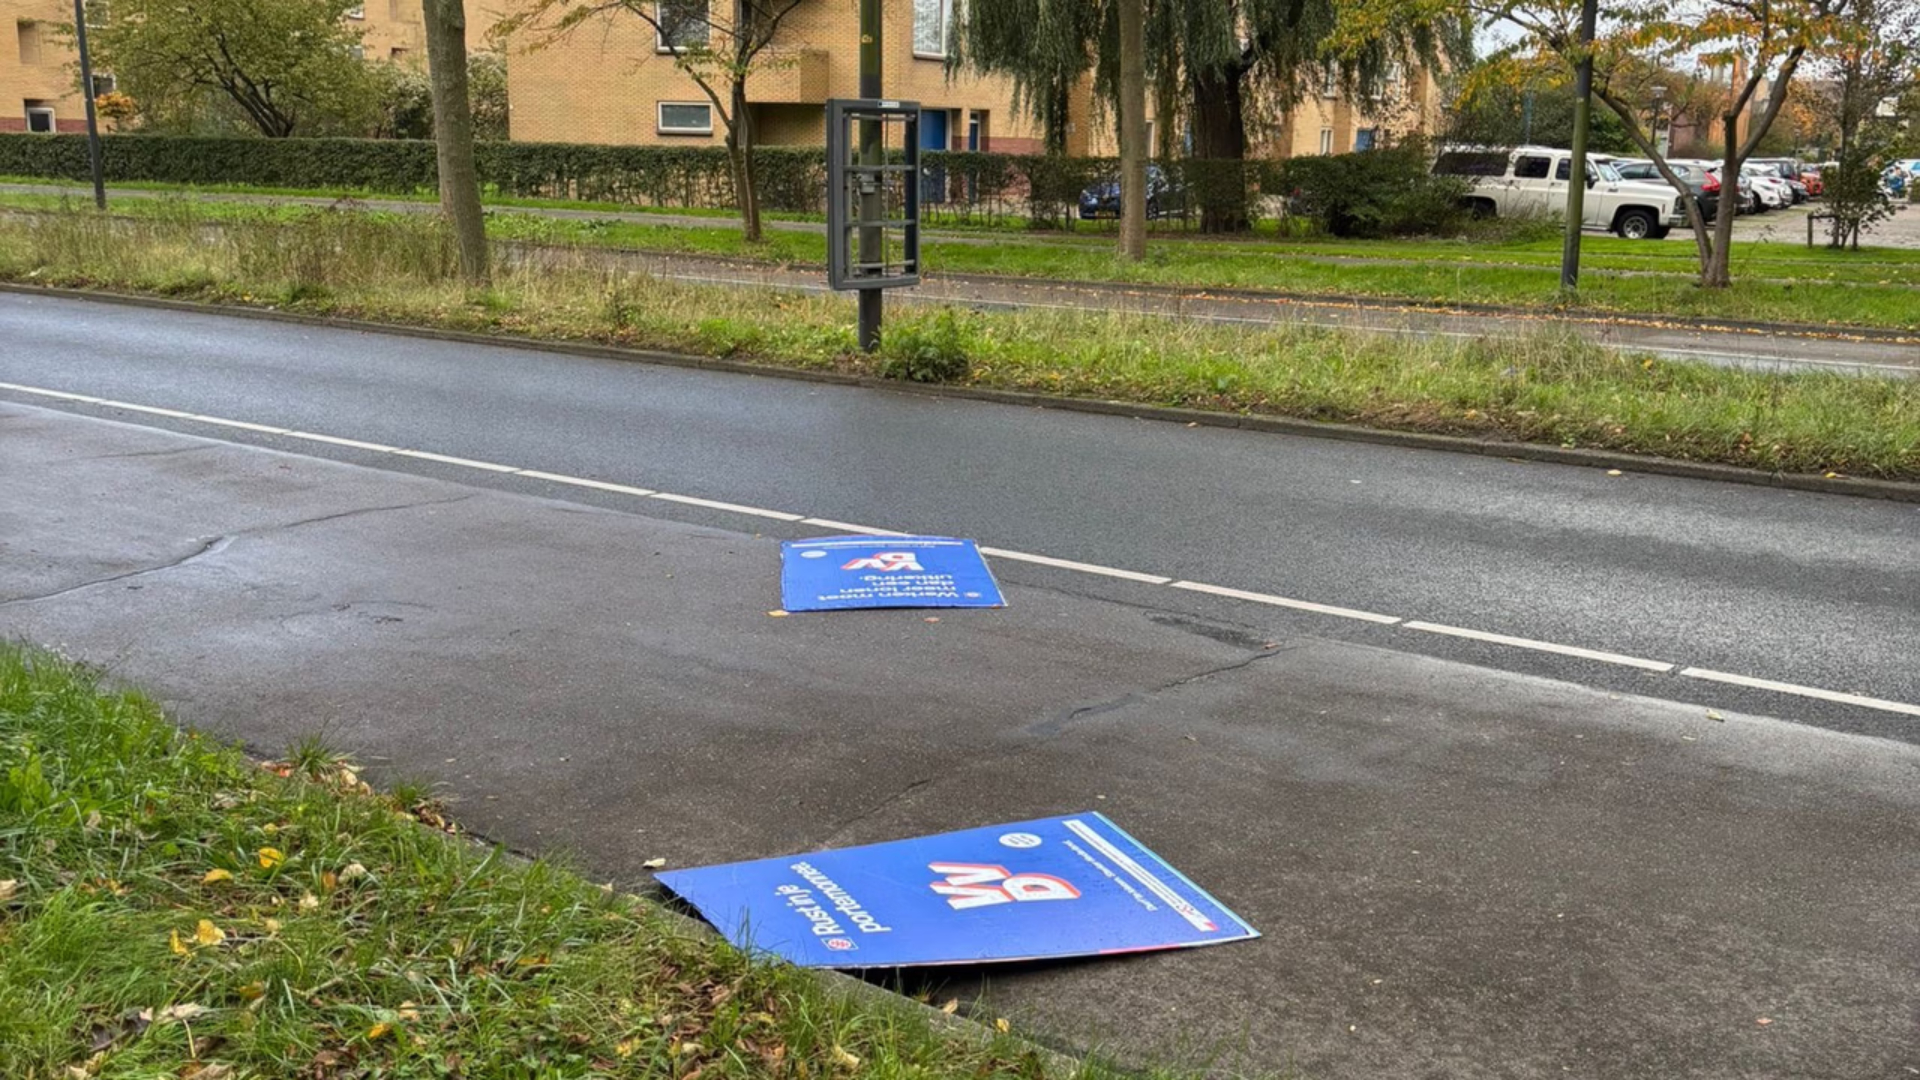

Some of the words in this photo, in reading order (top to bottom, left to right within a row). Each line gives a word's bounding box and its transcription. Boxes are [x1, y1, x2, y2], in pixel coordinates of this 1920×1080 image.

[840, 552, 925, 572] VVD
[818, 593, 873, 601] moet
[774, 884, 813, 896] je
[928, 861, 1082, 910] VVD
[785, 894, 817, 906] in
[795, 905, 845, 936] Rust
